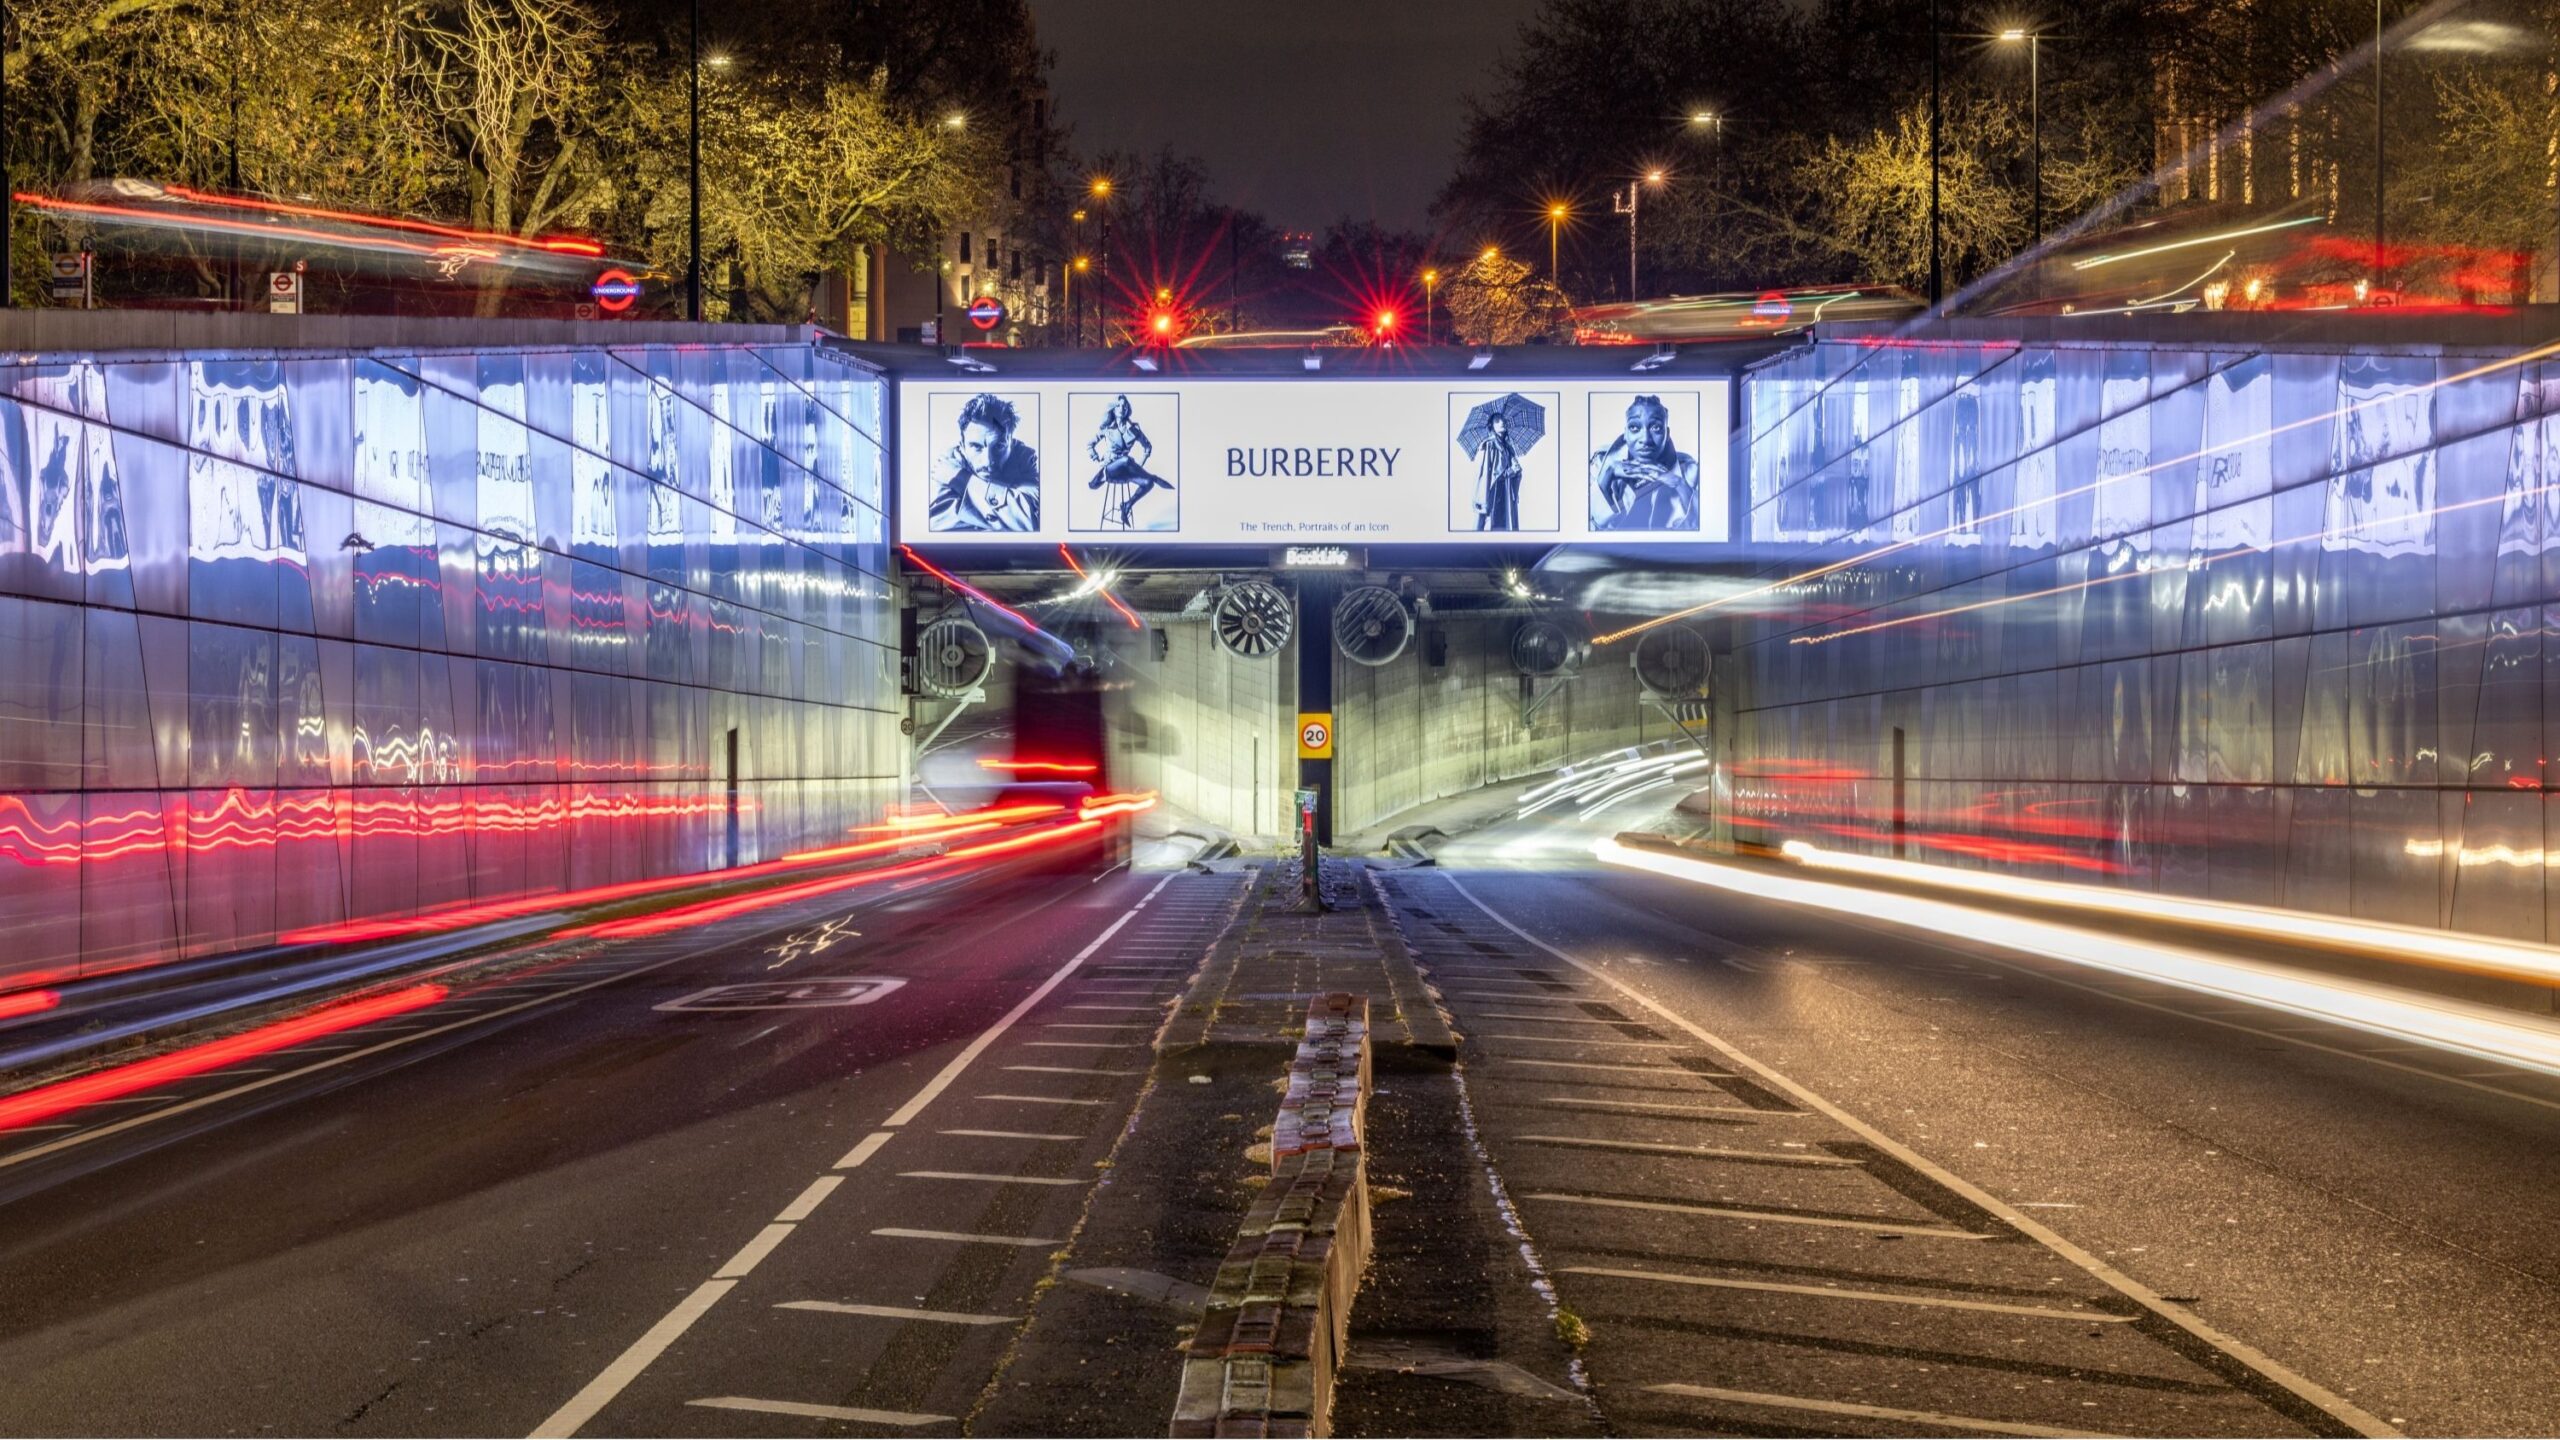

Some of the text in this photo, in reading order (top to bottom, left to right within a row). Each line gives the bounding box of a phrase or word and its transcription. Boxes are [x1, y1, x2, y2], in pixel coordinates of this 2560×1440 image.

[296, 260, 304, 271] S
[594, 286, 637, 294] UNDERGROUND
[1227, 447, 1402, 477] BURBERRY
[1240, 522, 1389, 533] The Trench, Portraits of an Icon
[902, 723, 913, 731] 20
[1306, 730, 1325, 742] 20
